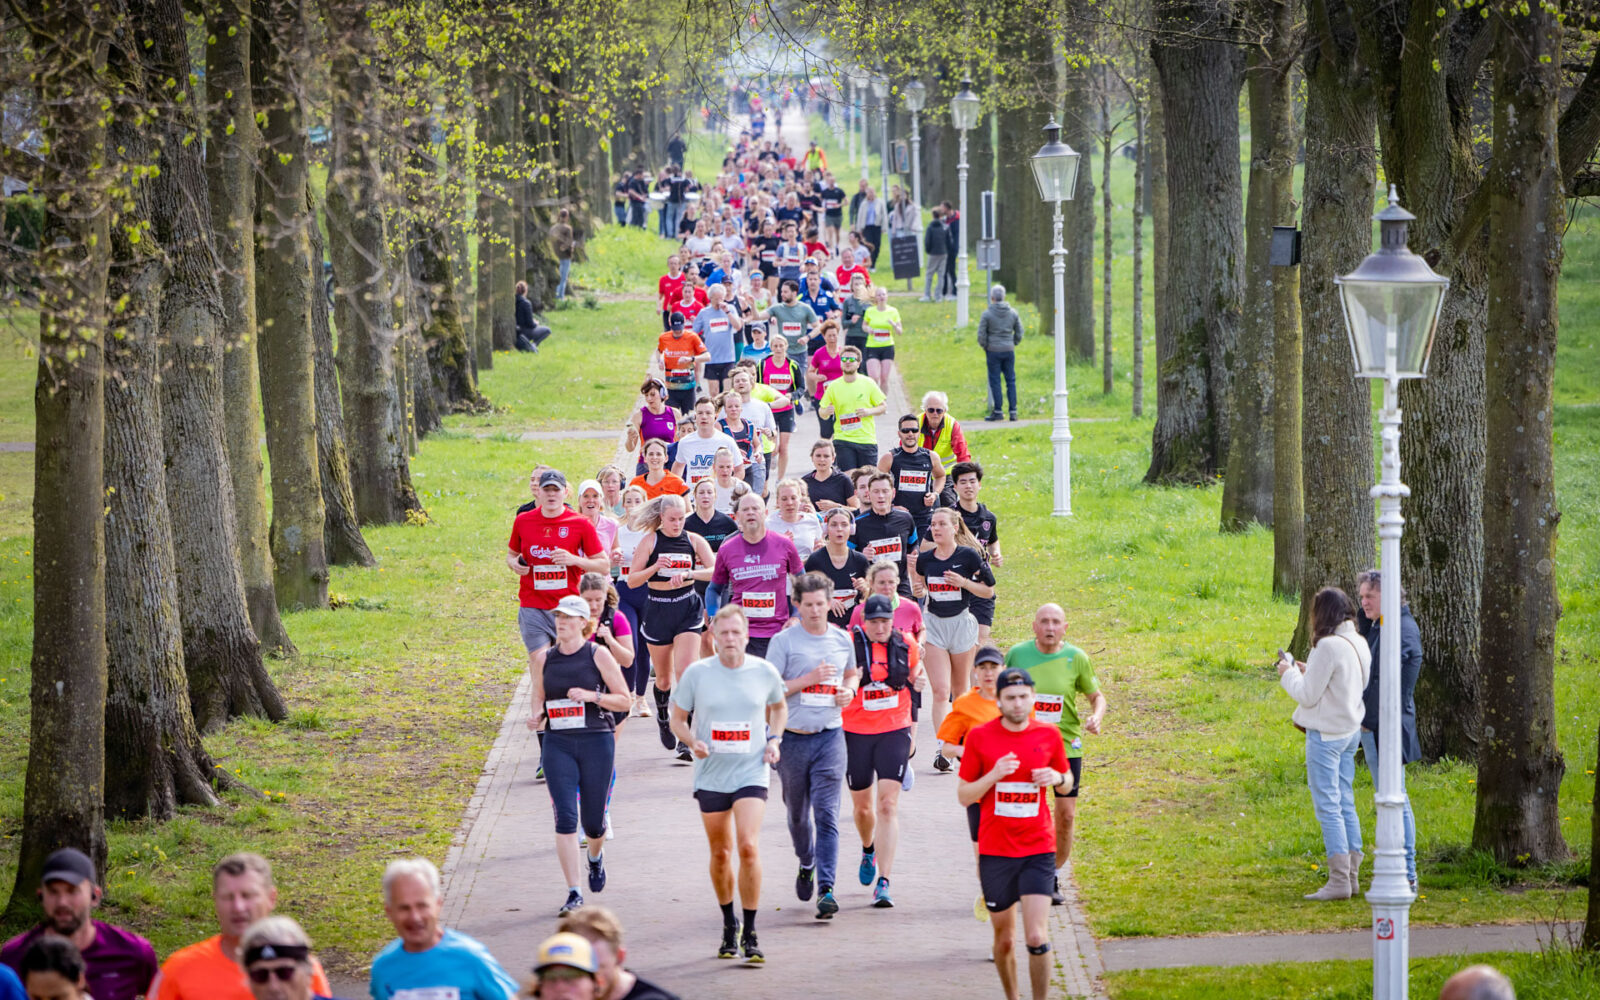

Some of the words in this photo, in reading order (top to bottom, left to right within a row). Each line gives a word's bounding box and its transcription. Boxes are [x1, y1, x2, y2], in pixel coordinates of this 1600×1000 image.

[901, 476, 926, 484] 18462
[530, 545, 558, 559] Carlsb
[535, 571, 566, 580] 18012
[743, 599, 774, 607] 18230
[1036, 702, 1061, 711] 320
[550, 707, 583, 718] 18161
[712, 730, 749, 740] 18215
[998, 792, 1037, 803] 18282
